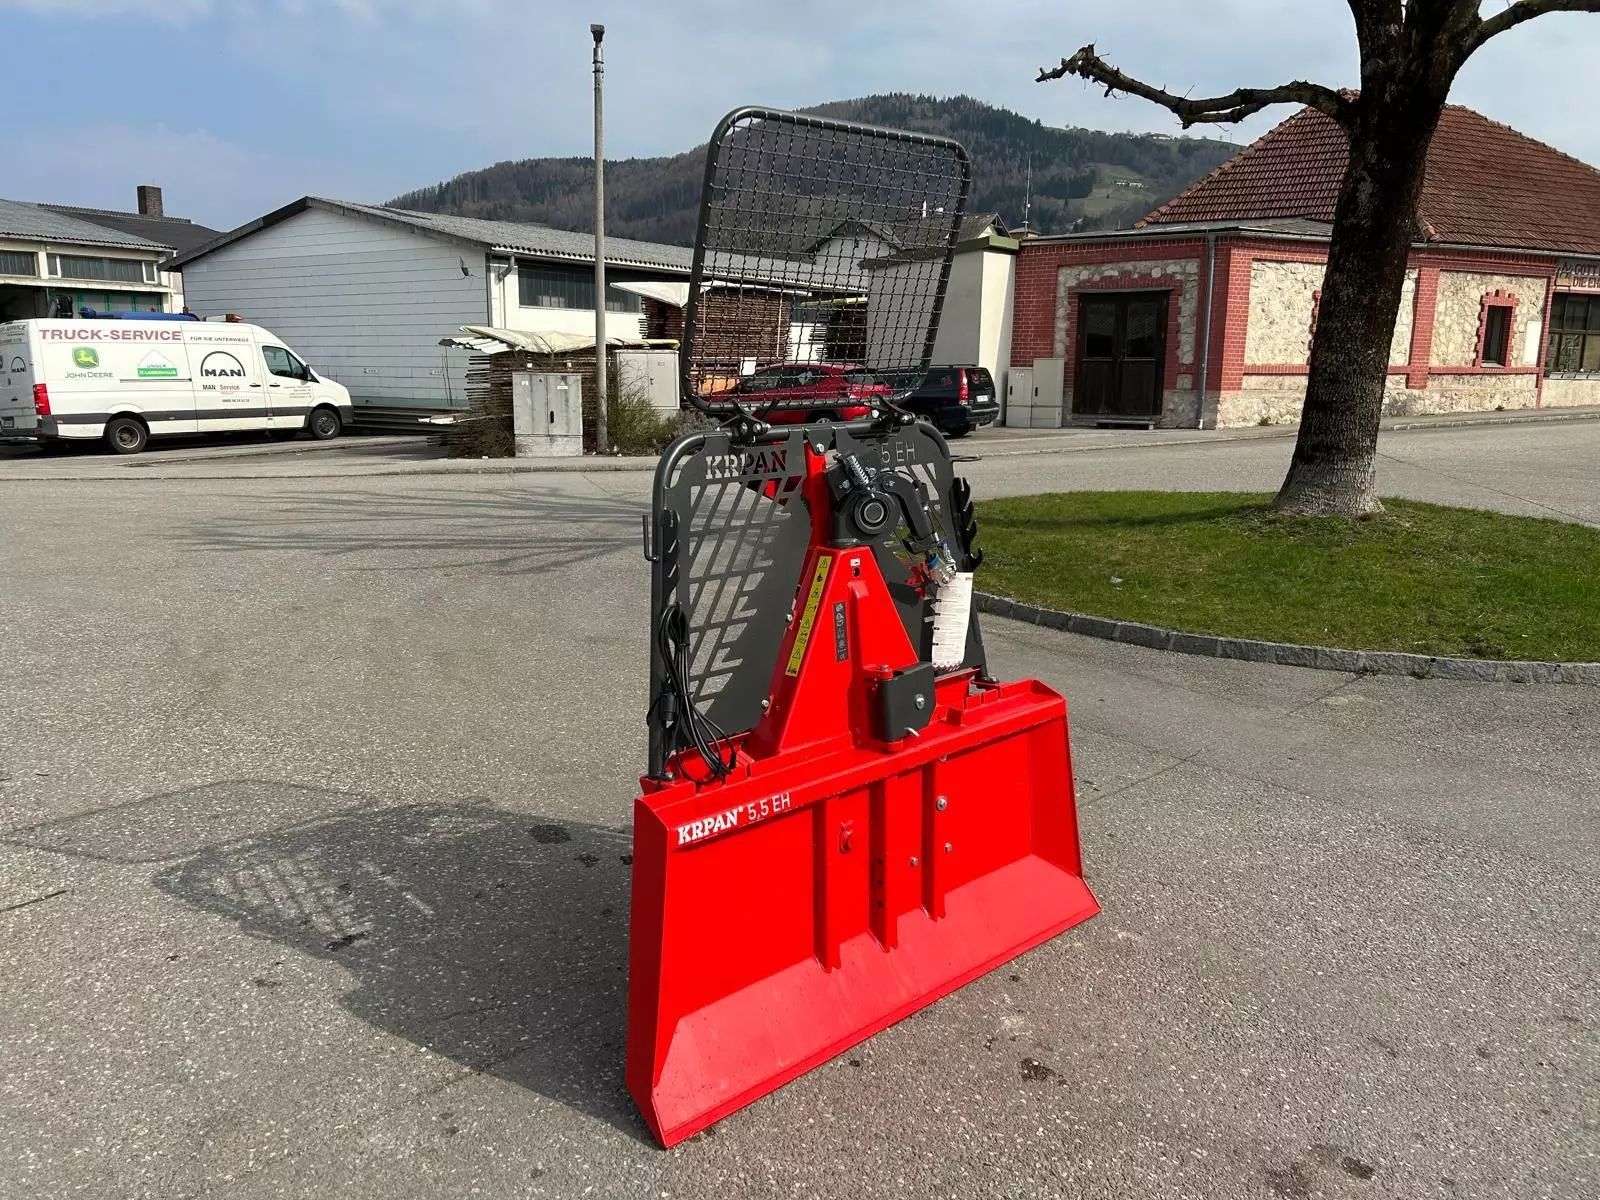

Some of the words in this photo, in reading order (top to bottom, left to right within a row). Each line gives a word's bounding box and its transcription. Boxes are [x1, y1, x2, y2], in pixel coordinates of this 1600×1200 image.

[39, 329, 182, 340] TRUCK-SERVICE
[204, 368, 242, 377] MAN
[895, 440, 916, 462] EH
[705, 449, 787, 480] KRPAN
[677, 808, 739, 846] KRPAN
[747, 799, 769, 821] 5,5
[771, 791, 791, 812] EH
